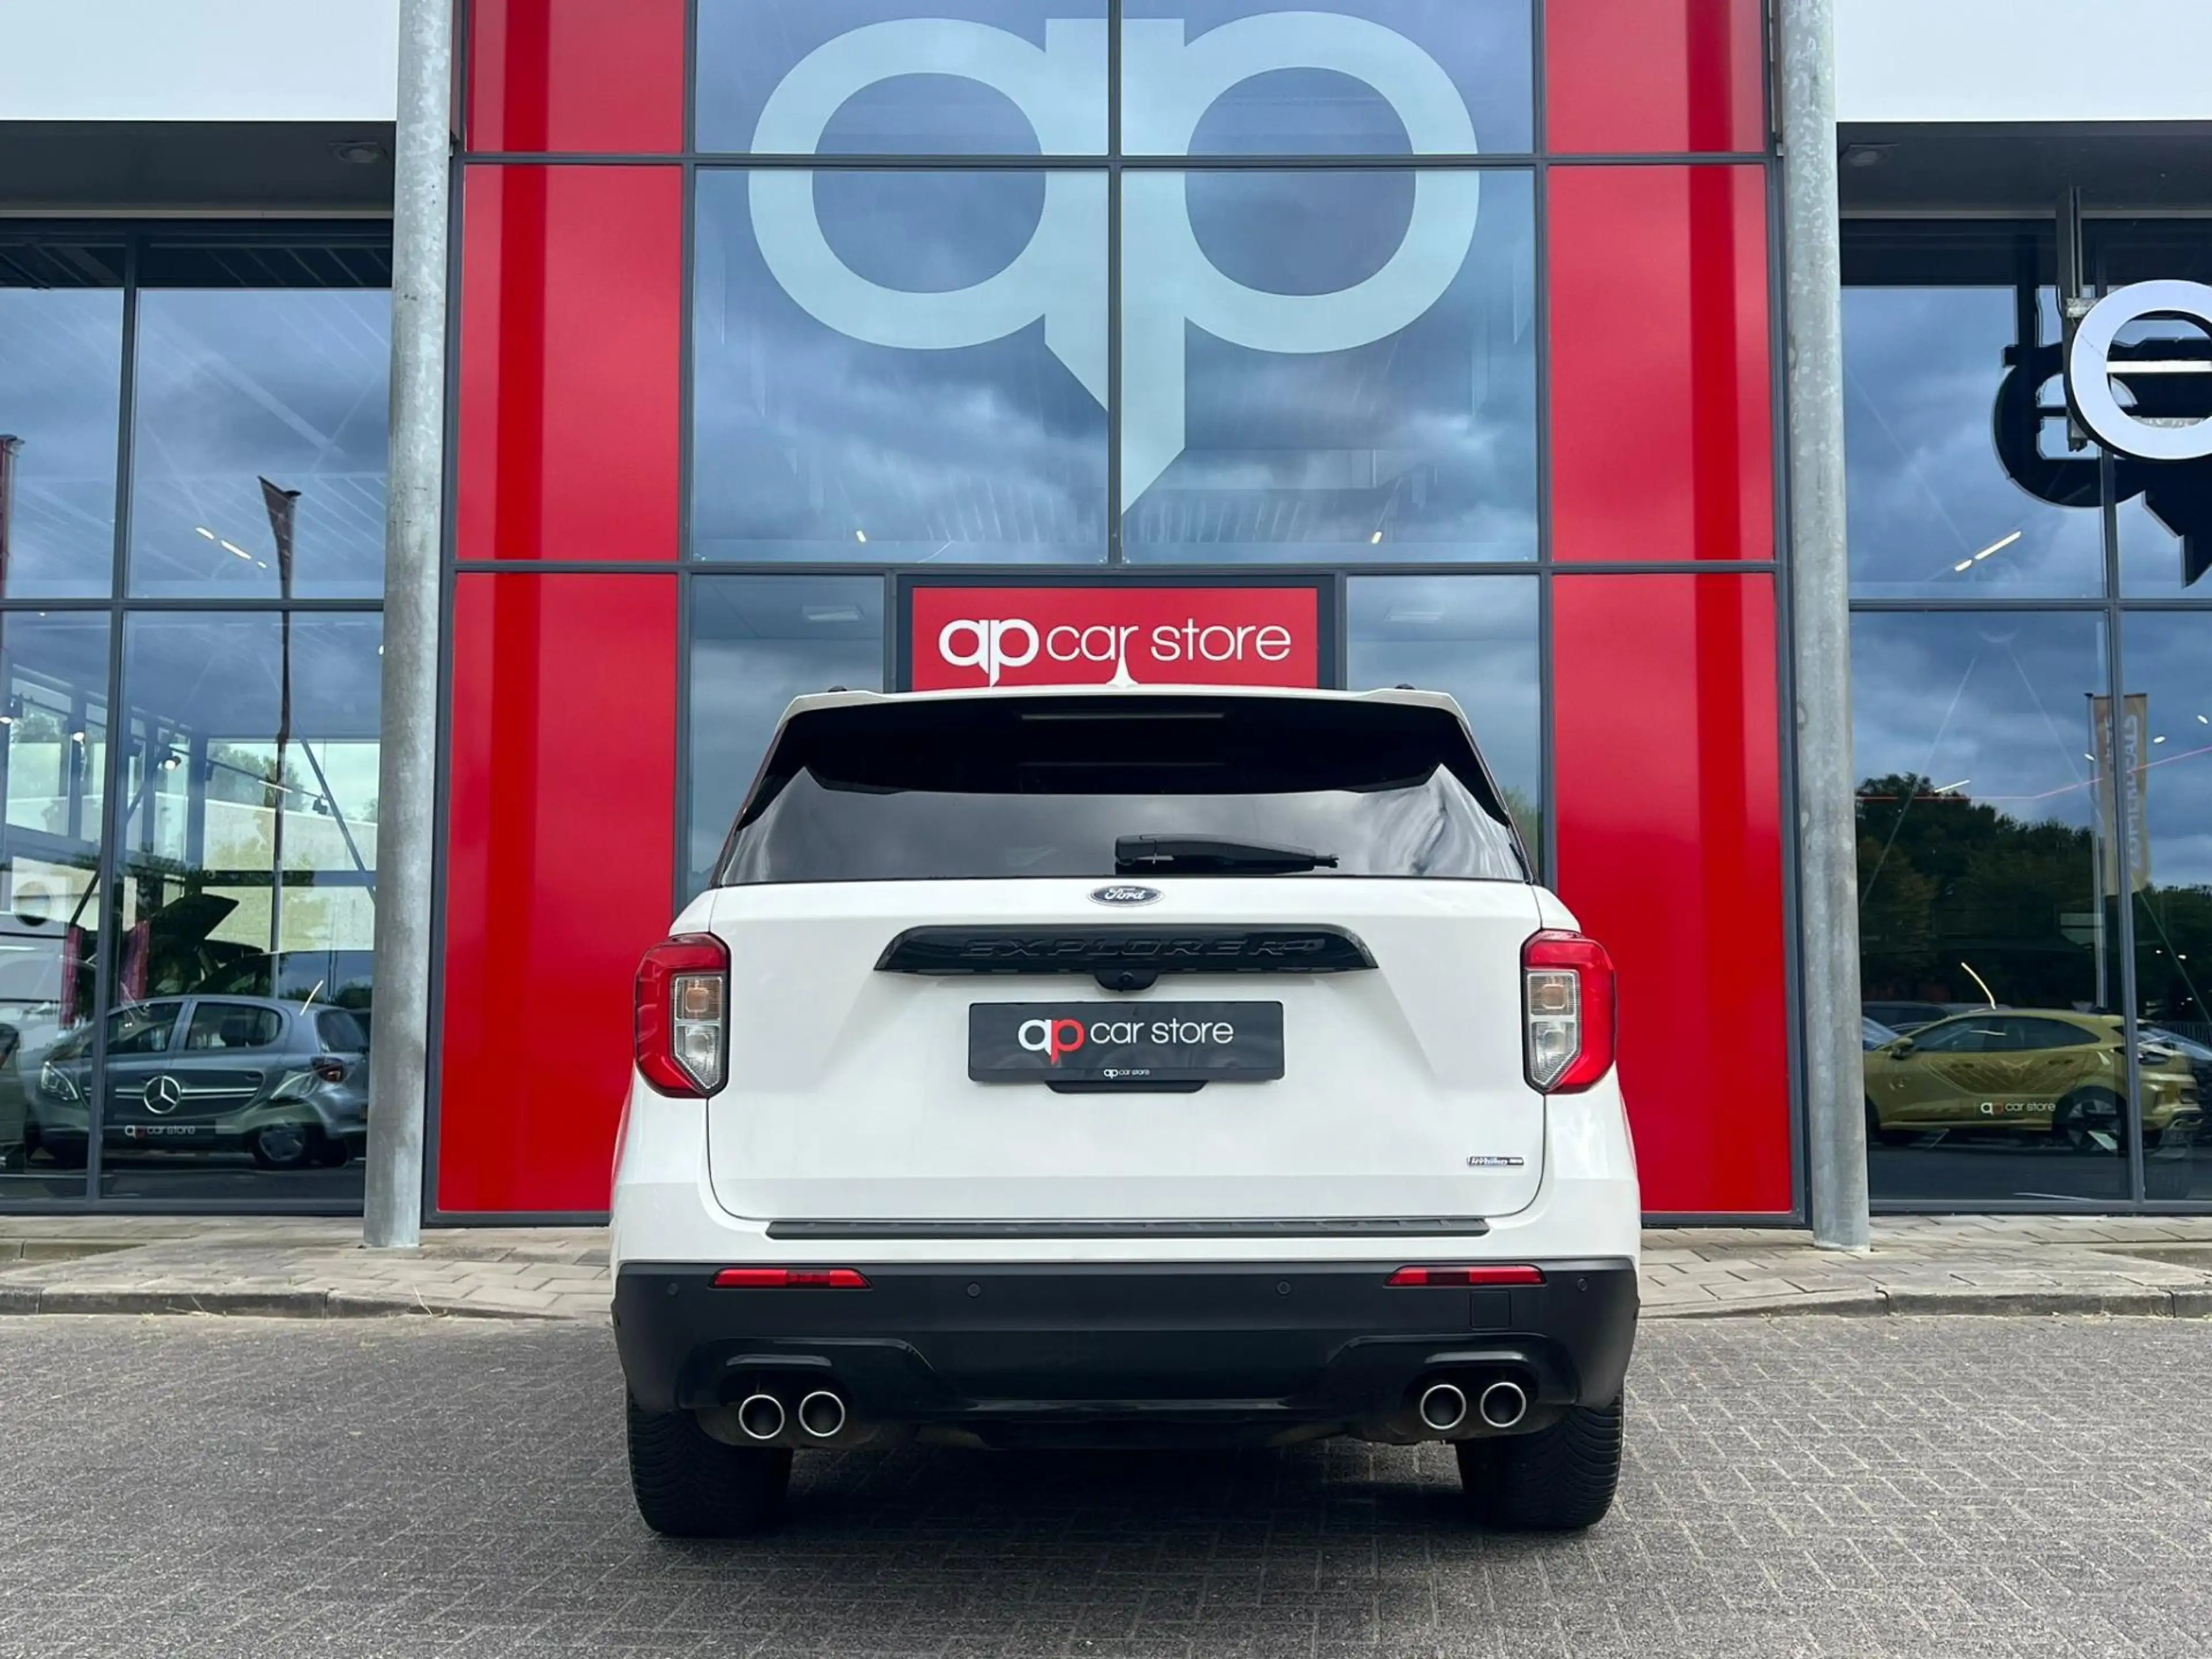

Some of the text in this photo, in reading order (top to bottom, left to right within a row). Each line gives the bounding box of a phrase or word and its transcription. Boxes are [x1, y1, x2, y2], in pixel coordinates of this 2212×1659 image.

[1046, 625, 1139, 662] car
[1150, 618, 1291, 662] store
[1104, 887, 1146, 900] Ford
[960, 937, 1285, 957] EXPLORER
[1090, 1021, 1145, 1044] car
[1151, 1017, 1234, 1044] store
[2005, 1103, 2024, 1112] car
[2027, 1101, 2056, 1112] store
[147, 1125, 165, 1135] car
[166, 1124, 196, 1135] store
